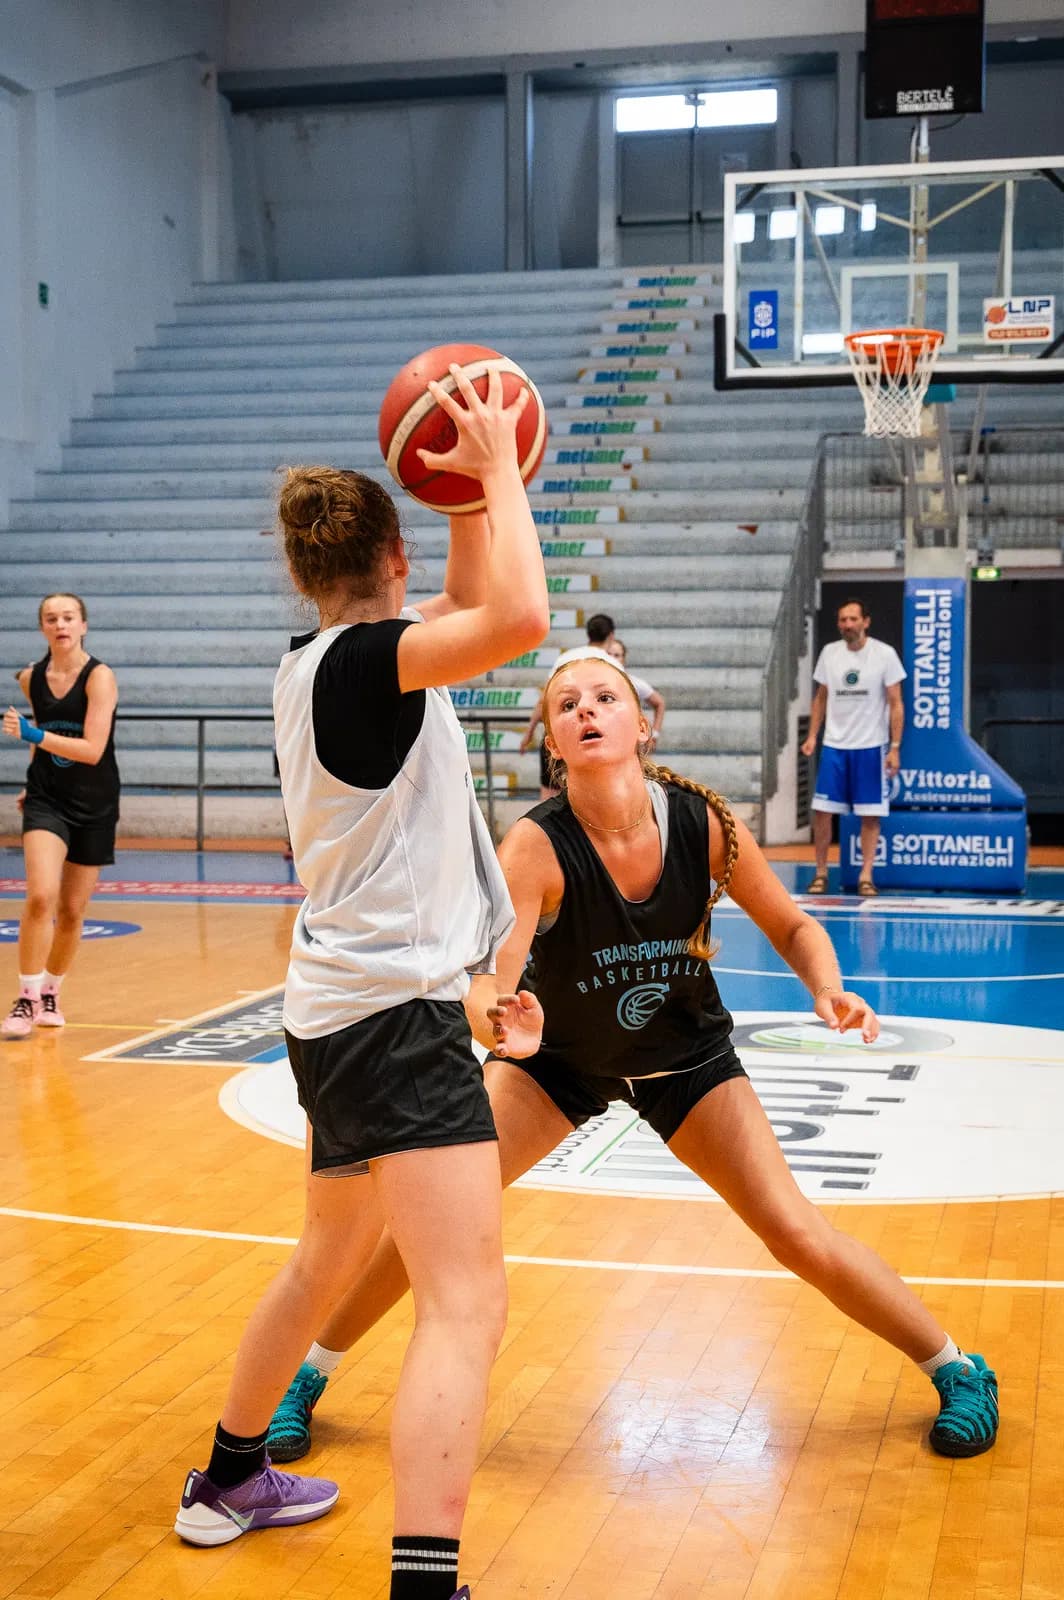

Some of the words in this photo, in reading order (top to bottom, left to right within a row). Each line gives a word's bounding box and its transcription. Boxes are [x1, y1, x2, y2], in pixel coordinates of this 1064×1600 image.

[1008, 300, 1050, 313] LNP
[913, 589, 936, 729] SOTTANELLI
[936, 589, 952, 729] assicurazioni
[900, 769, 992, 789] Vittoria
[892, 834, 1014, 854] SOTTANELLI
[892, 852, 1014, 868] assicurazioni
[577, 961, 701, 994] BASKETBALL
